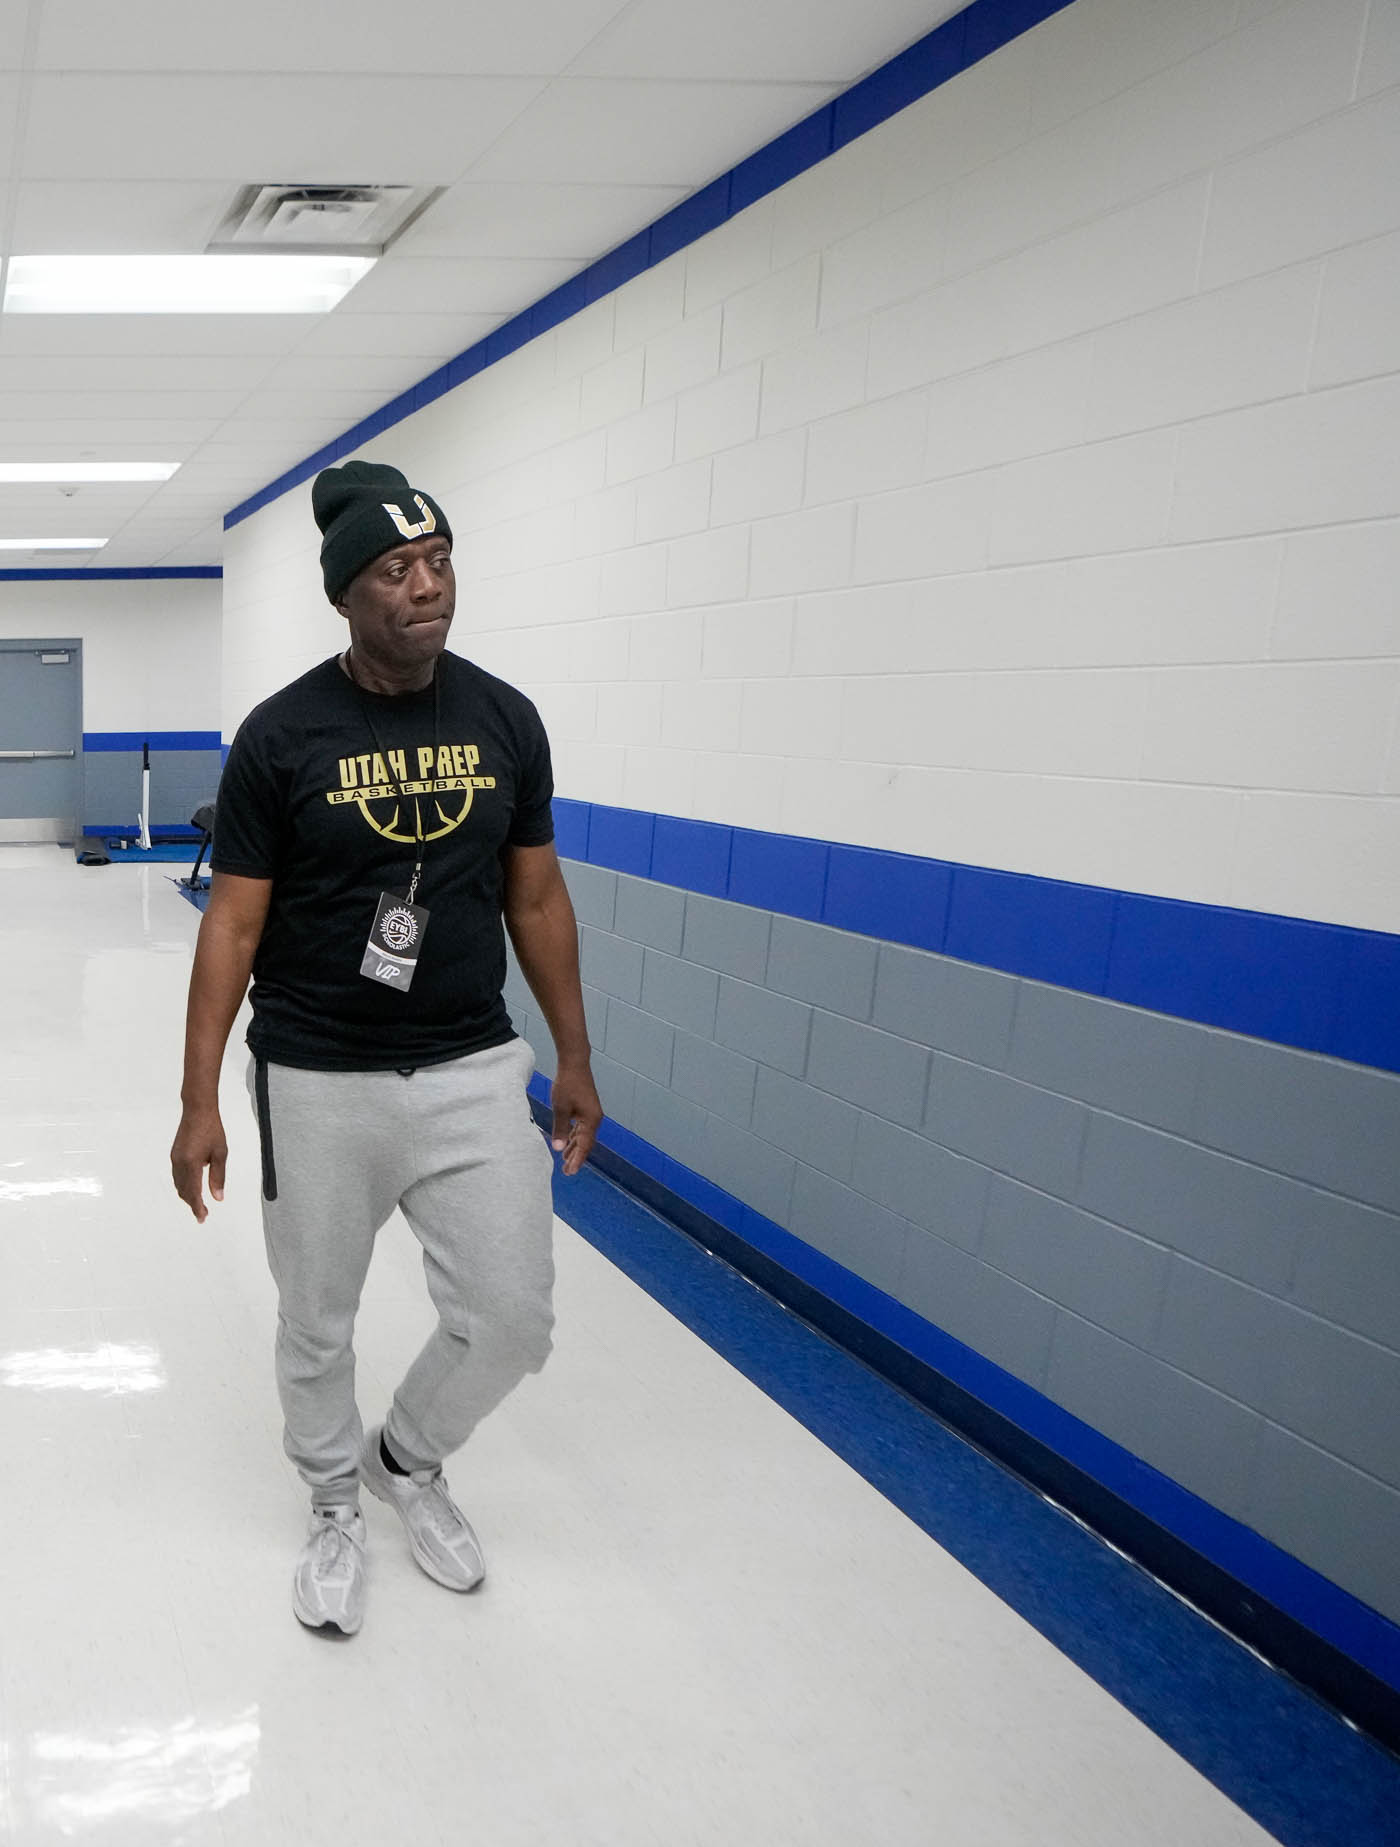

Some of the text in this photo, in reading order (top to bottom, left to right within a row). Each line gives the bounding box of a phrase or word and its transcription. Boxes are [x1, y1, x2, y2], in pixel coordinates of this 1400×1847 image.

[339, 744, 480, 788] UTAH PREP
[333, 778, 492, 803] BASKETBALL
[376, 962, 400, 979] VIP
